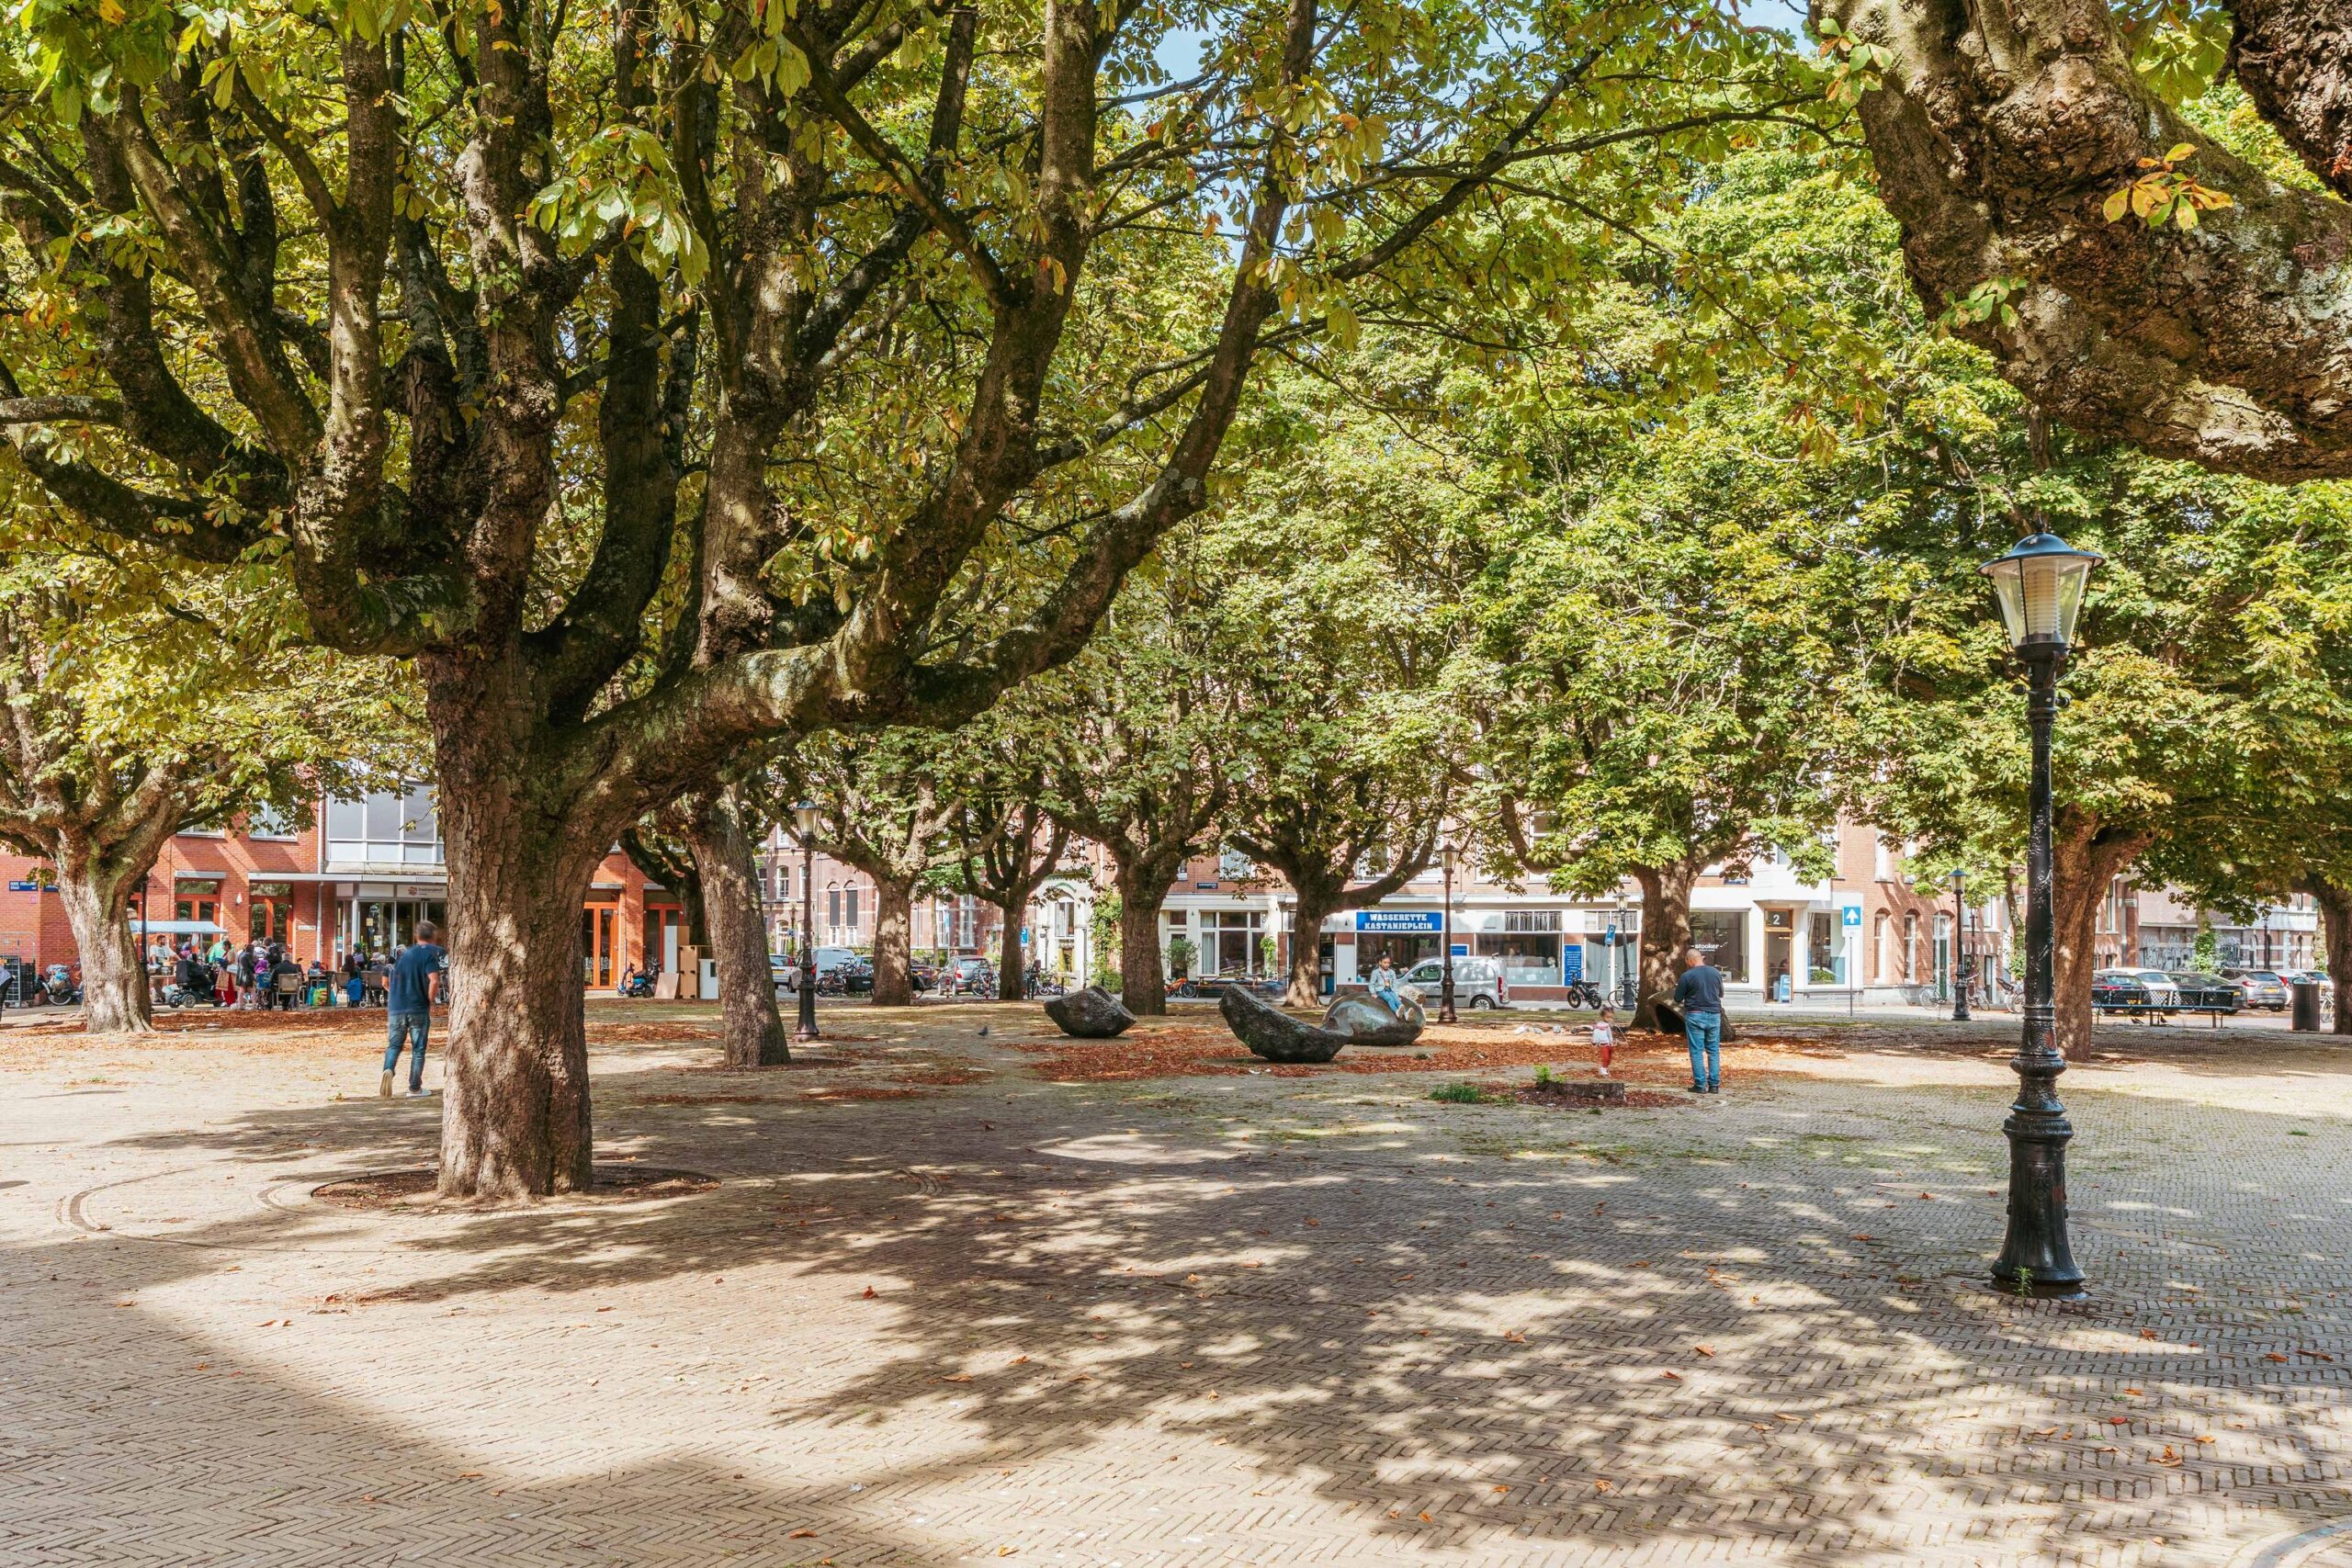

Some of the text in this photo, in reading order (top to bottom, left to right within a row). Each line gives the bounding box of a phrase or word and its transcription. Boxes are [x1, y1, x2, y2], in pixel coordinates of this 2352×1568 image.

[1369, 913, 1428, 921] WASSERETTE
[1772, 914, 1781, 925] 2
[1608, 926, 1614, 936] P
